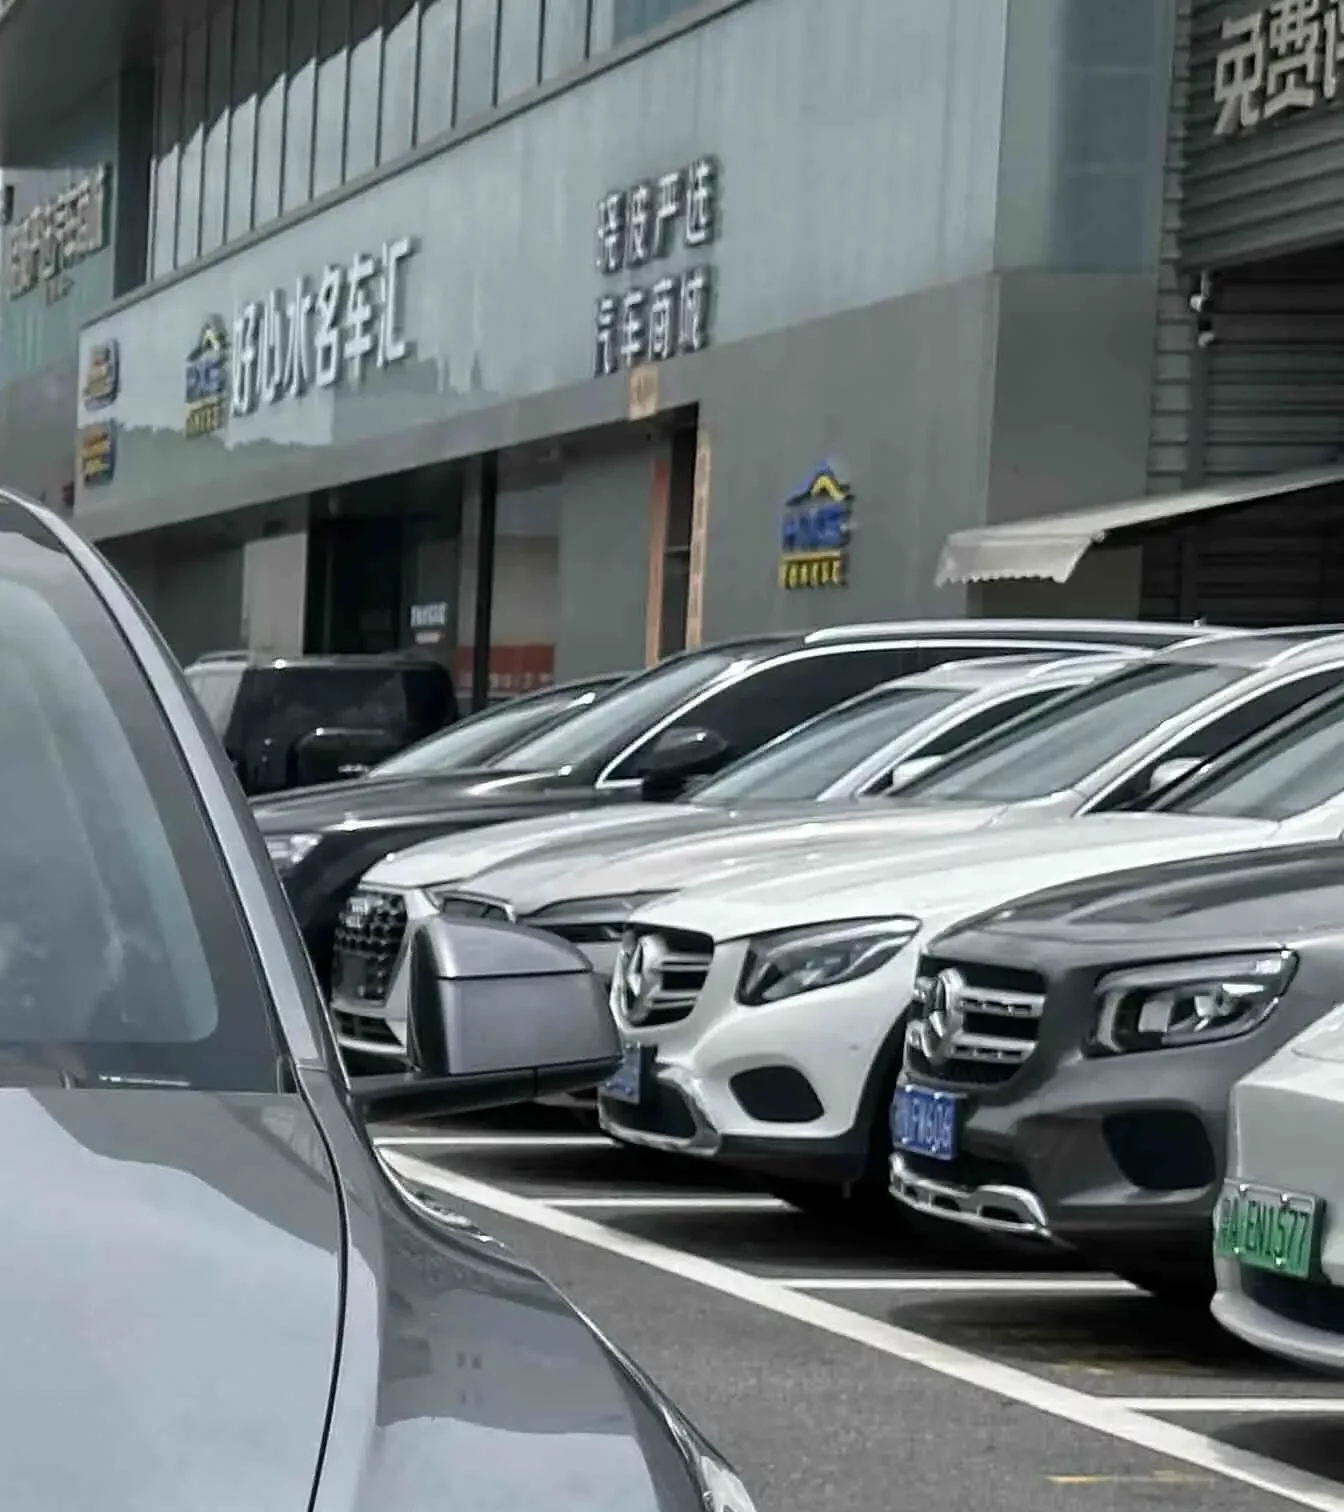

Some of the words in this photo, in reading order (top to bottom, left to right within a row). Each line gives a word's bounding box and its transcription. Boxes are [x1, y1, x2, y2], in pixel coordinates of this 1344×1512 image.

[231, 235, 412, 417] 好心水名车汇
[593, 270, 706, 378] 汽车商城
